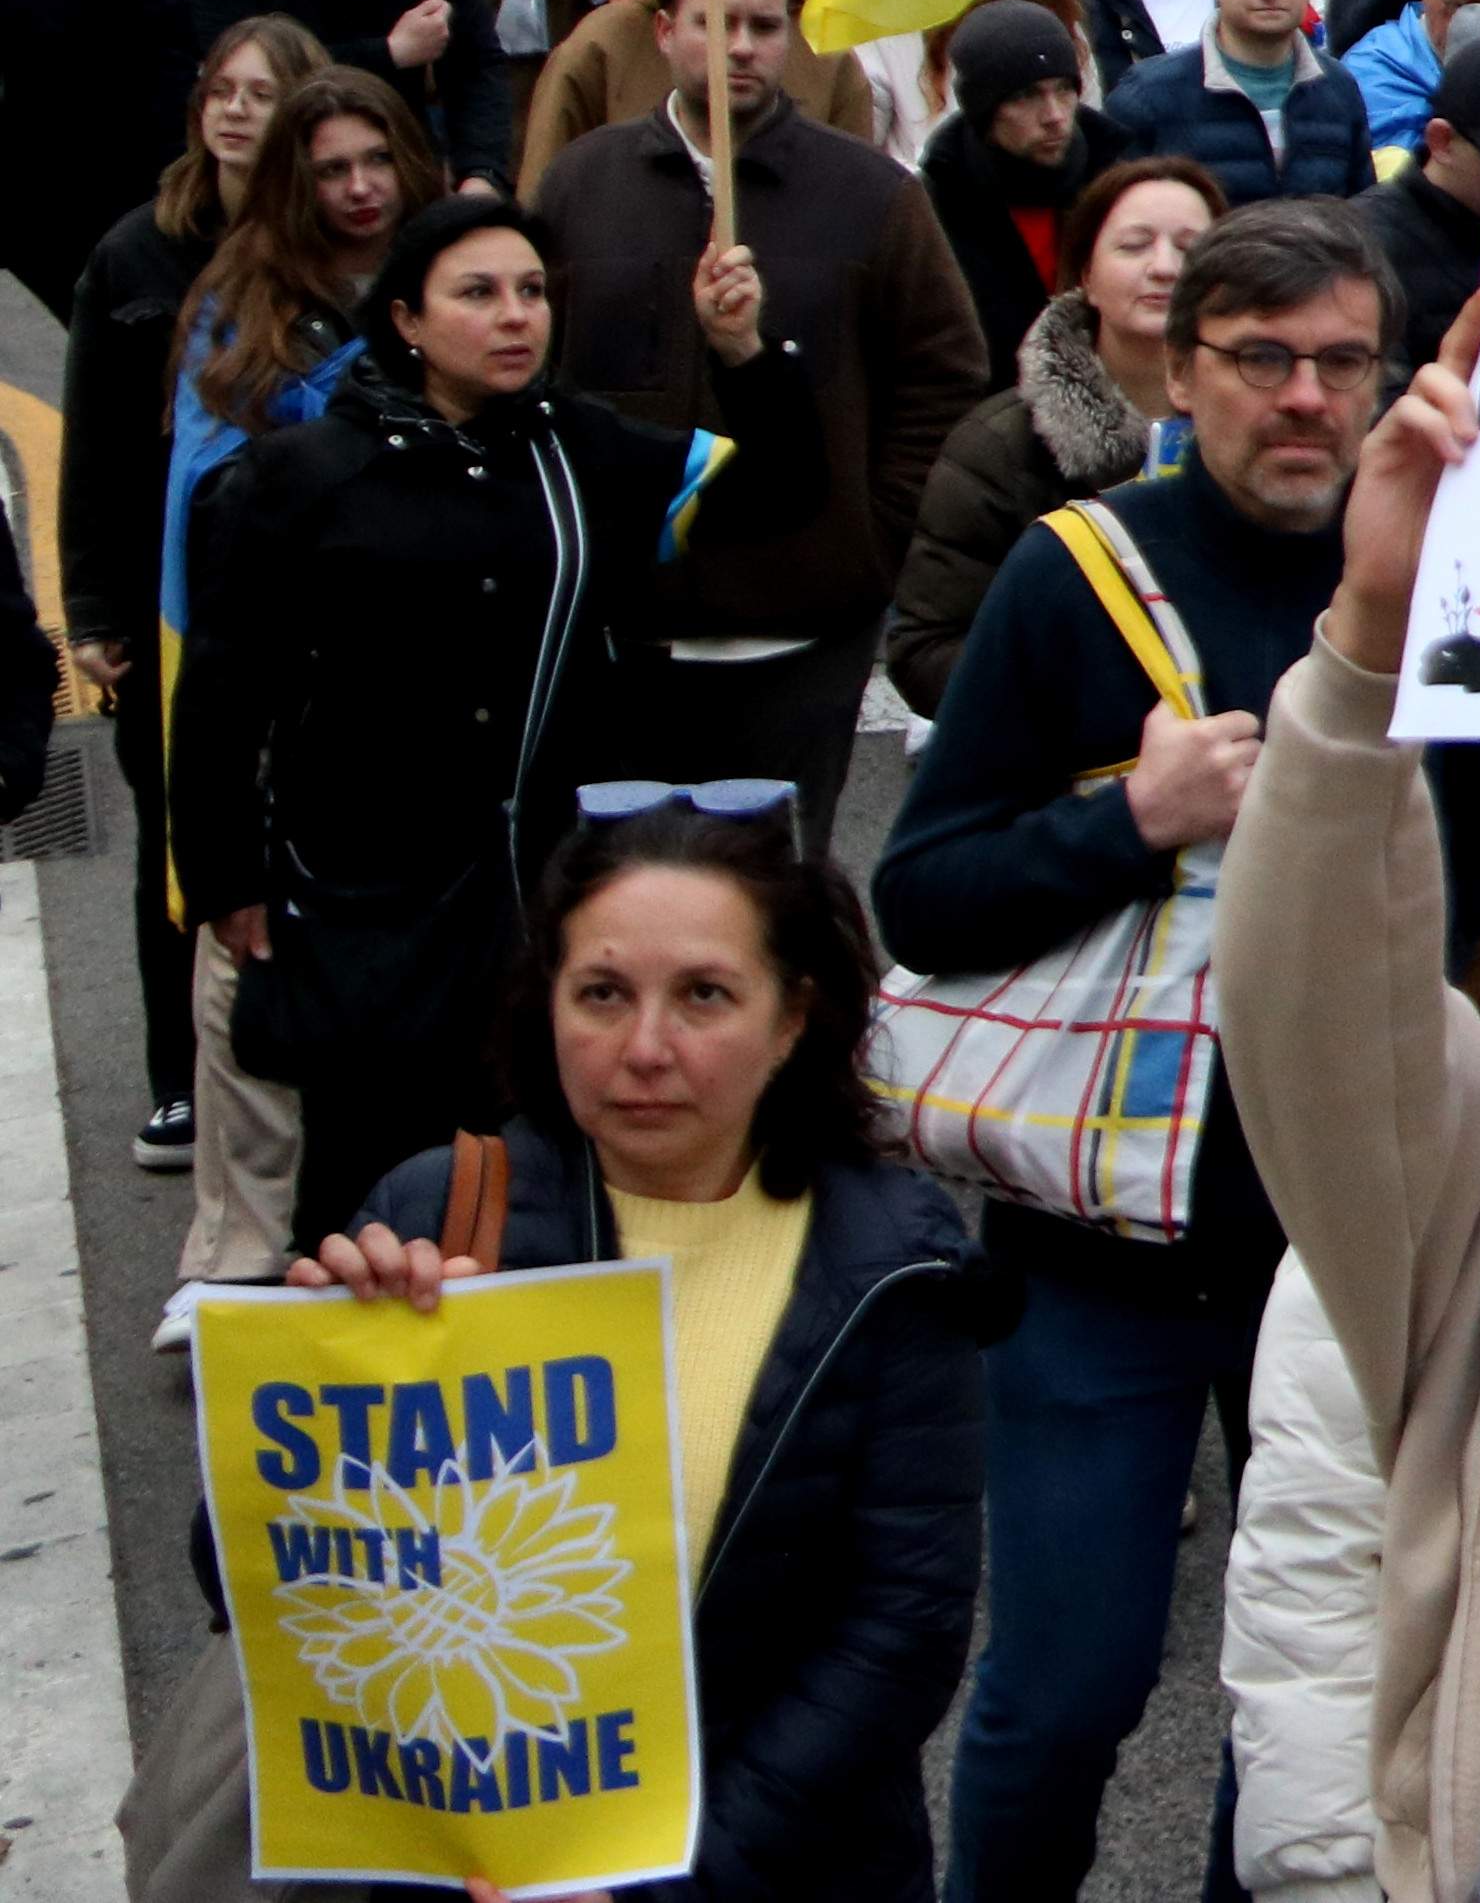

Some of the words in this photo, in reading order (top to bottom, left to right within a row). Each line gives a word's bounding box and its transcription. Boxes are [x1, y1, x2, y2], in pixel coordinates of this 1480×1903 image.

[251, 1354, 618, 1491] STAND
[267, 1521, 443, 1592] WITH
[299, 1709, 641, 1814] UKRAINE
